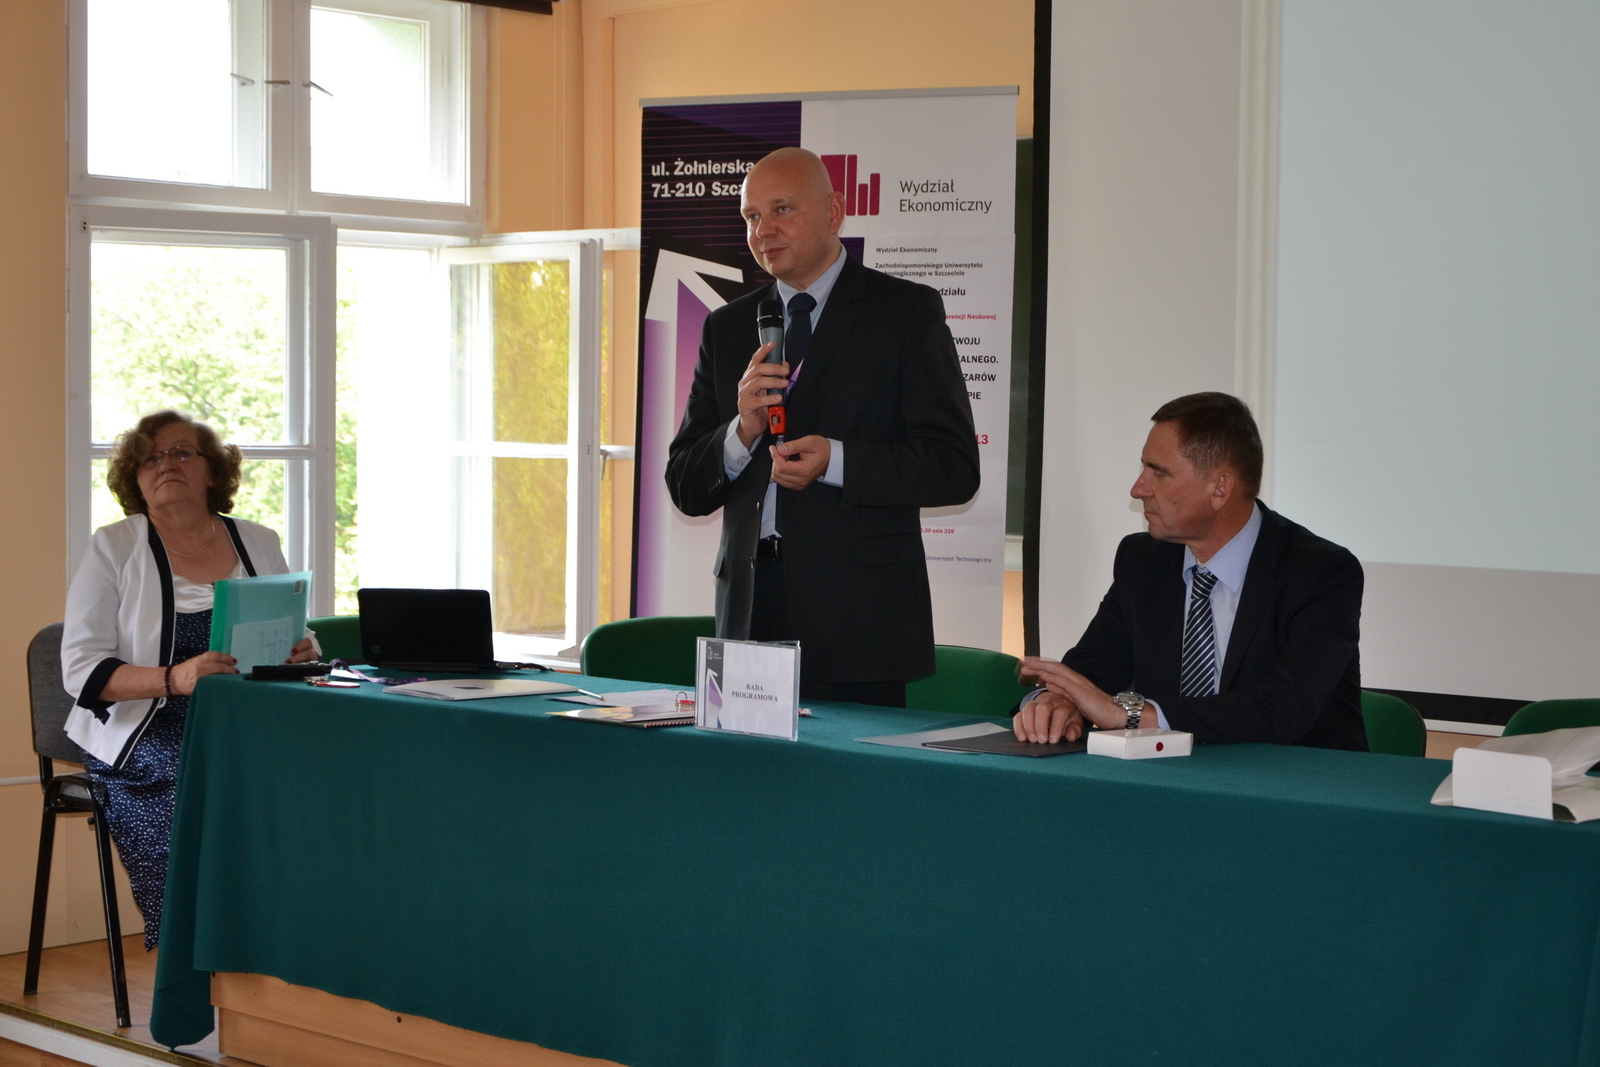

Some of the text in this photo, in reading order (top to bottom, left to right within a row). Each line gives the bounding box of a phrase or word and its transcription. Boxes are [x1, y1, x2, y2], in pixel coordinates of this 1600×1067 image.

[651, 157, 755, 176] ul. Żołnierska
[651, 182, 706, 198] 71-210
[899, 179, 955, 197] Wydział
[899, 198, 993, 214] Ekonomiczny
[899, 246, 938, 254] Ekonomiczny
[874, 262, 944, 270] Zachodniopomorskiego
[944, 313, 997, 321] erencji Naukowej
[959, 355, 999, 364] ALNEGO.
[955, 555, 993, 564] Technologiczny
[746, 683, 764, 692] RADA
[731, 691, 778, 702] PROGRAMOWA
